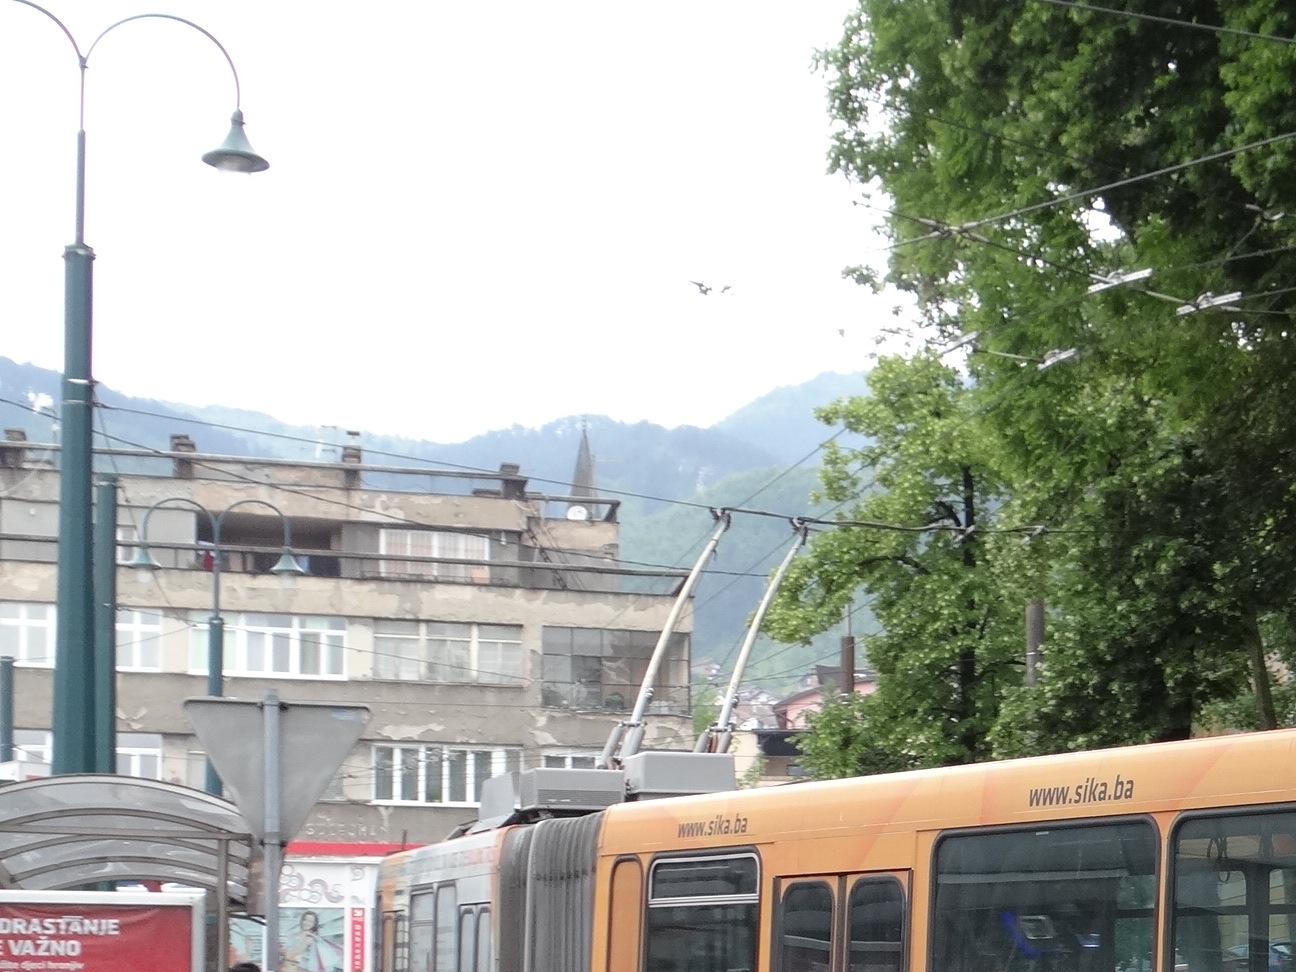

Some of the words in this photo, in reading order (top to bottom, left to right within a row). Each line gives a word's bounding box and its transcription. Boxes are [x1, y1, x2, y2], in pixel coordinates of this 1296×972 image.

[1028, 774, 1134, 807] www.sika.ba
[677, 813, 748, 838] www.sika.ba
[7, 936, 82, 956] VAŽNO
